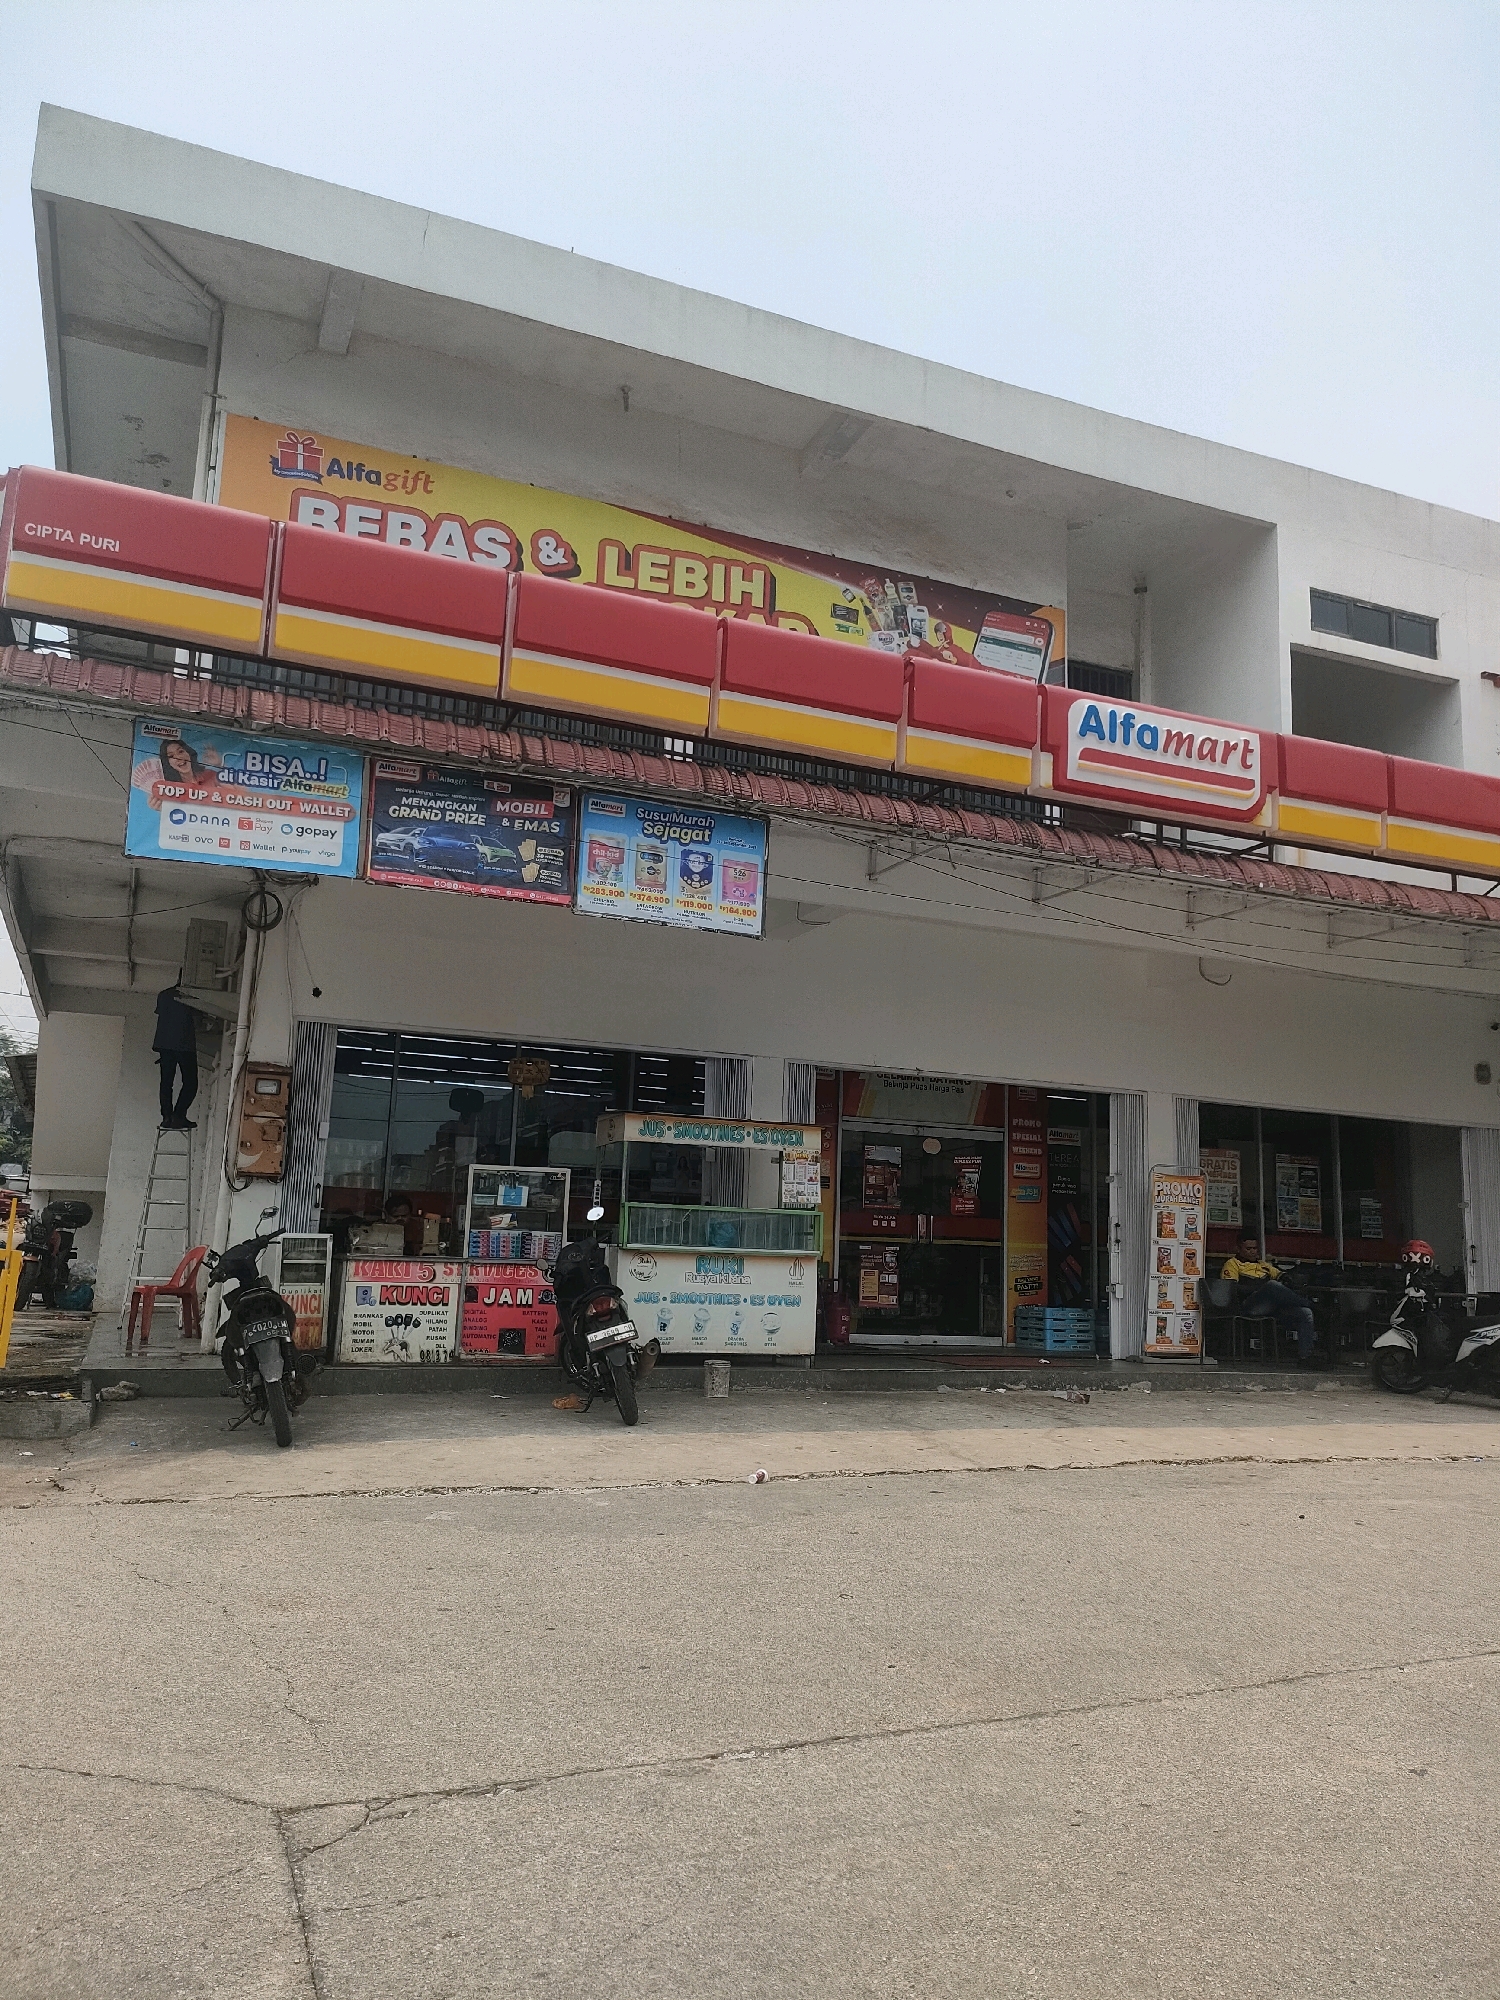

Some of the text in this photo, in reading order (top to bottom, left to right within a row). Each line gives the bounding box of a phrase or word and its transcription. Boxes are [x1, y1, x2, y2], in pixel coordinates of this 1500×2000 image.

[326, 457, 435, 495] Alfagift
[24, 522, 120, 553] CIPTA PURI
[537, 535, 569, 567] &
[603, 545, 765, 609] LEBIH
[143, 723, 178, 735] Alfamart
[1078, 703, 1255, 771] Alfamart
[379, 762, 417, 775] Alfamart
[218, 768, 348, 798] di Kasir Alfamart
[157, 783, 350, 818] TOP UP & CASH OUT WALLET
[401, 796, 477, 813] MENANGKAN
[496, 800, 549, 815] MOBIL
[590, 800, 624, 812] Alfamart
[189, 813, 231, 827] DANA
[388, 805, 487, 827] GRAND PRIZE
[254, 823, 273, 834] Pay
[296, 826, 338, 840] gopay
[501, 818, 560, 834] & EMAS
[643, 820, 712, 844] Sejagat
[252, 843, 276, 852] Wallet
[951, 1085, 964, 1094] Pas
[1012, 1118, 1042, 1128] PROMO
[638, 1119, 805, 1147] JUS SMOOTHIES ES OYEN
[1048, 1129, 1079, 1140] Alfamart
[1012, 1146, 1043, 1155] WEEKEND
[1200, 1159, 1238, 1171] GRATIS
[1154, 1181, 1203, 1198] PROMO
[1155, 1195, 1178, 1204] MURAH
[353, 1260, 412, 1279] KAKI
[416, 1262, 436, 1282] 5
[695, 1255, 745, 1275] RUKI
[281, 1287, 322, 1295] Duplikat
[378, 1285, 451, 1307] KUNCI
[483, 1286, 534, 1308] JAM
[633, 1291, 802, 1308] JUS SMOOTHIES ES OYEN
